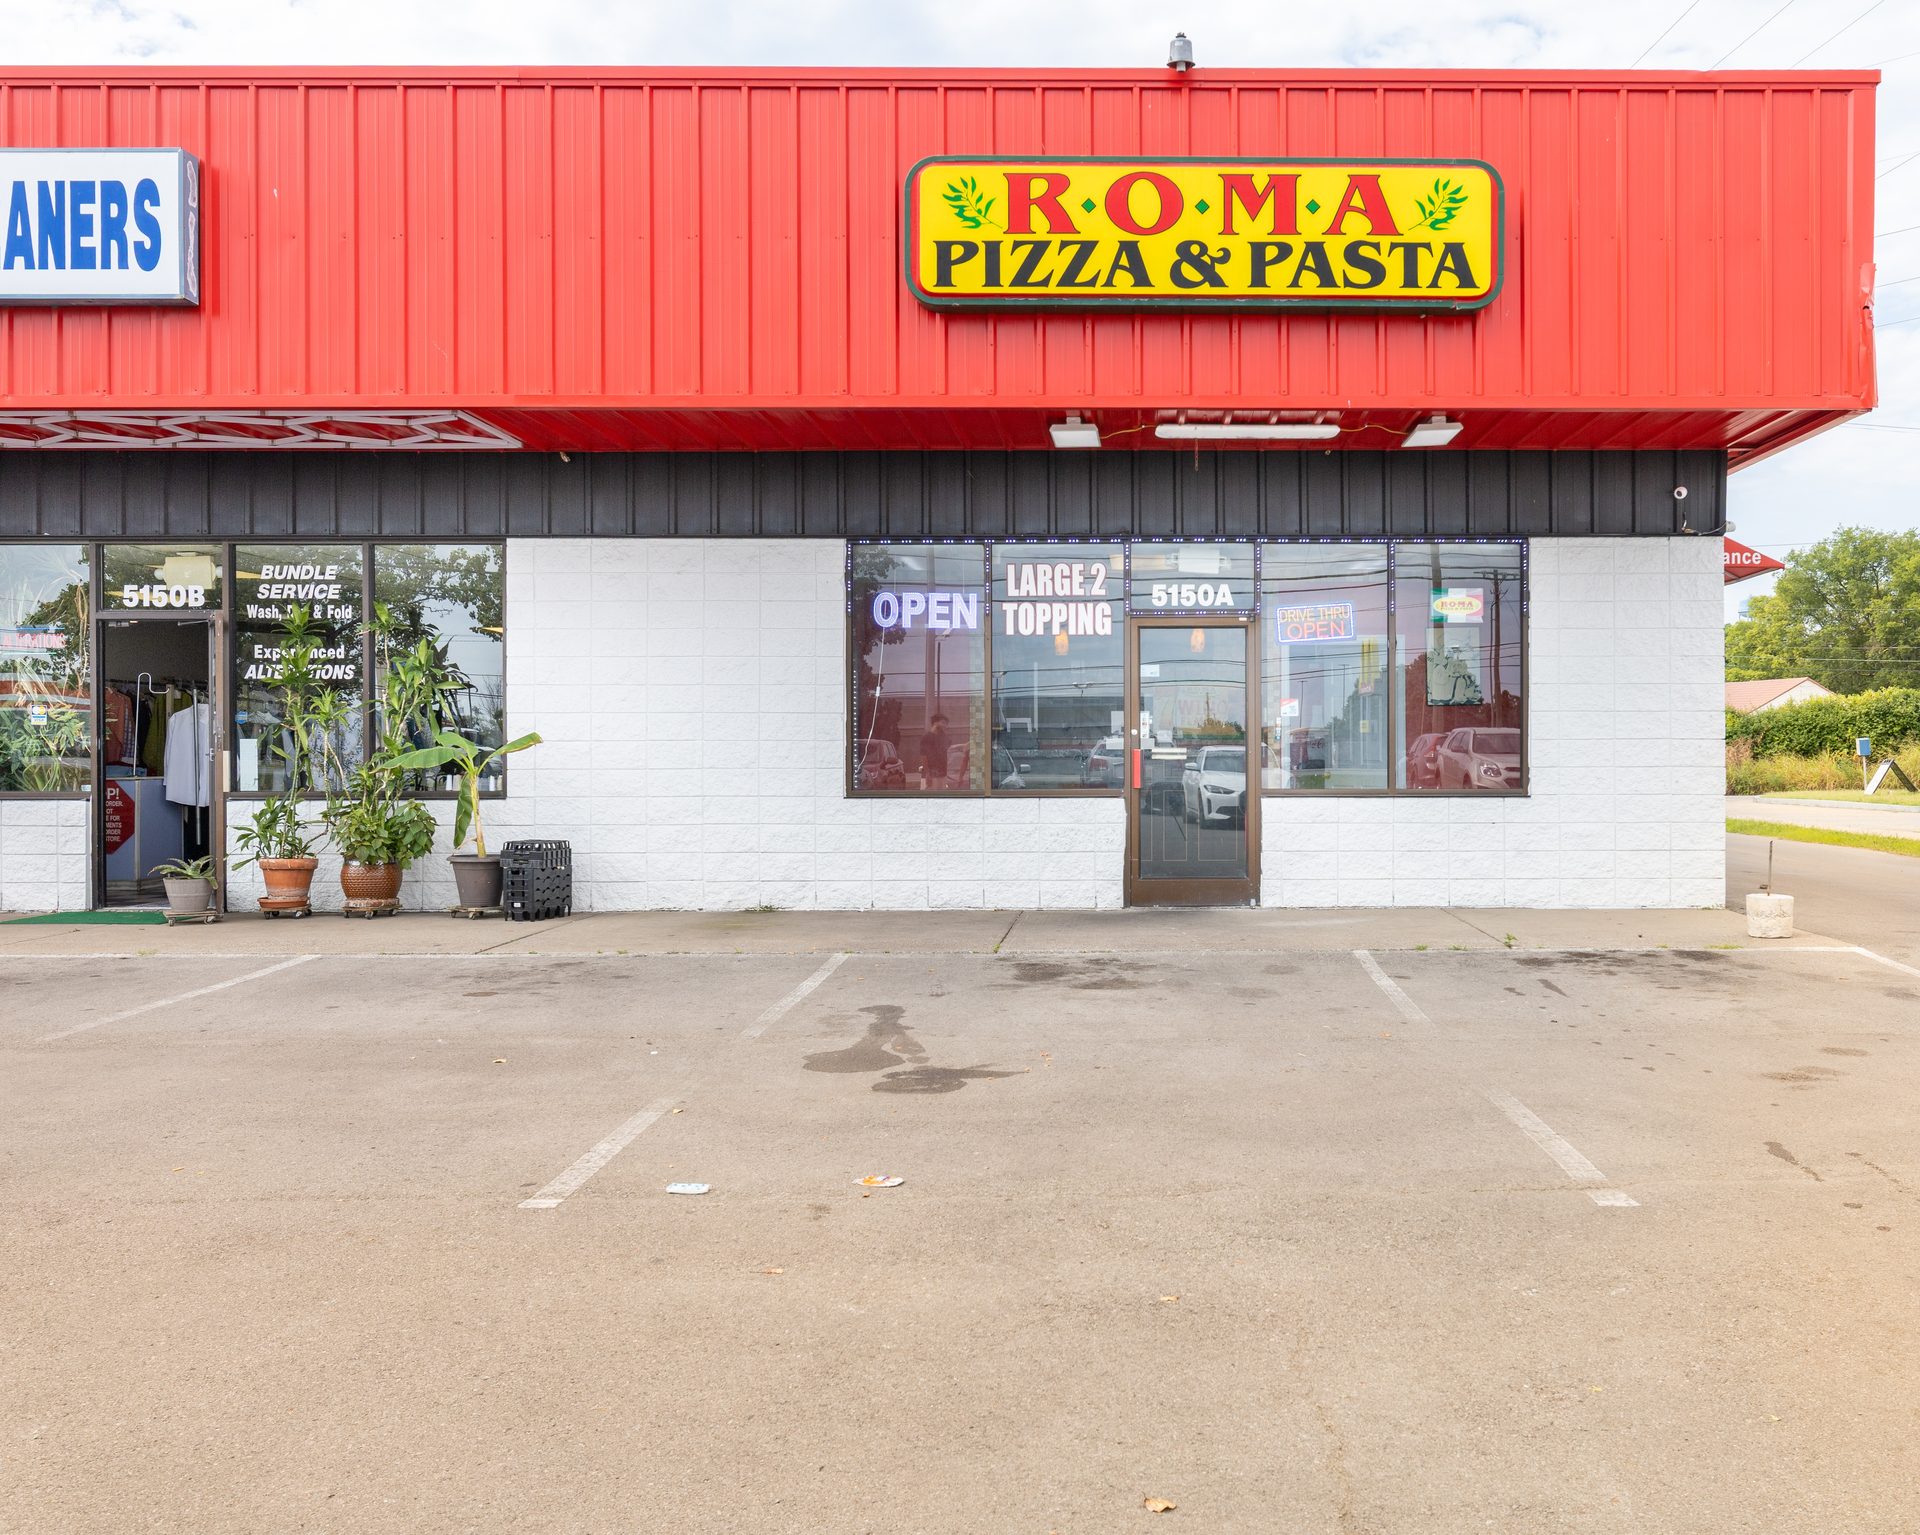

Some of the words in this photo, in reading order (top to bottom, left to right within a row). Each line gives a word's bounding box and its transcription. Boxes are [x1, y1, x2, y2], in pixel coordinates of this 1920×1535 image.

[2, 178, 162, 272] ANERS
[932, 239, 1155, 289] PIZZA
[1168, 238, 1232, 290] &
[1246, 240, 1481, 290] PASTA
[261, 565, 339, 580] BUNDLE
[1006, 562, 1086, 597] LARGE
[1089, 562, 1108, 597] 2
[122, 584, 206, 608] 5150B
[256, 583, 342, 599] SERVICE
[1151, 583, 1234, 608] 5150A
[246, 604, 282, 621] Wash,
[313, 604, 322, 619] &
[327, 604, 353, 619] Fold
[873, 592, 978, 629] OPEN
[1002, 602, 1113, 636] TOPPING
[1279, 607, 1315, 623] DRIVE
[1317, 605, 1350, 620] THRU
[1287, 620, 1345, 640] OPEN
[254, 645, 345, 661] Expernced
[244, 664, 356, 680] ALTETIONS
